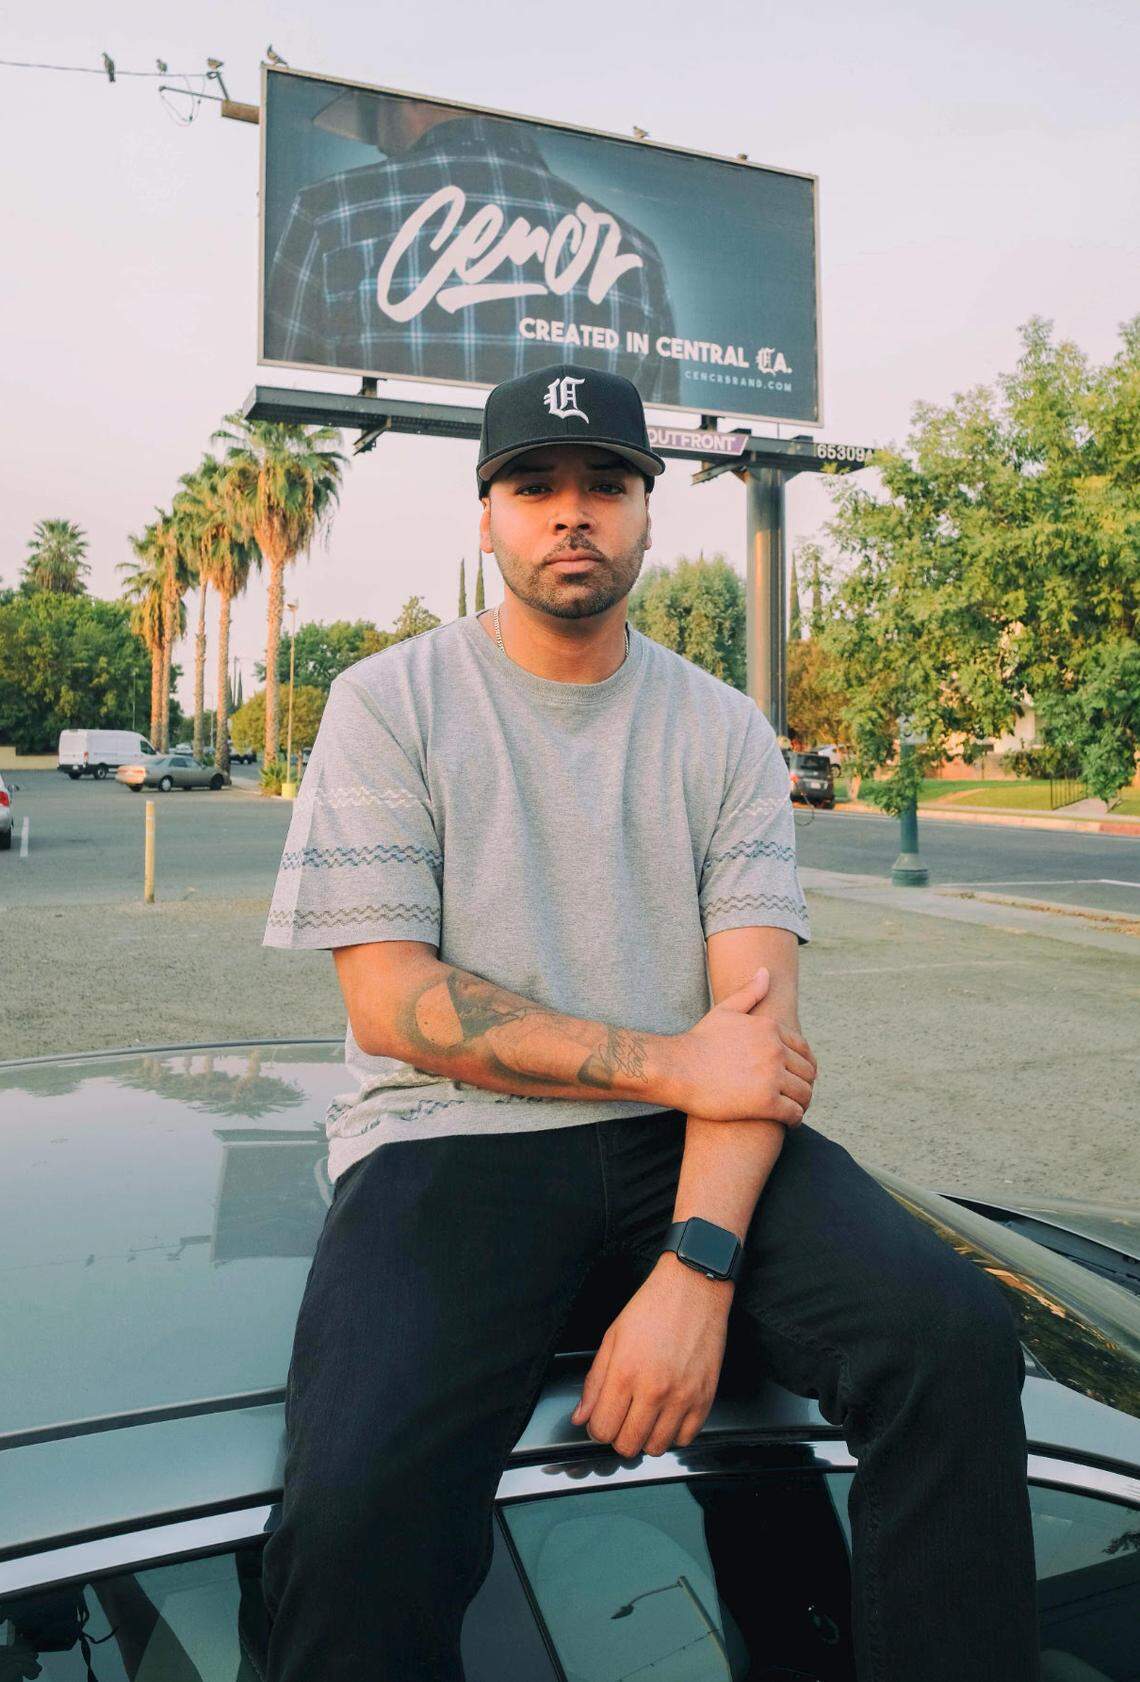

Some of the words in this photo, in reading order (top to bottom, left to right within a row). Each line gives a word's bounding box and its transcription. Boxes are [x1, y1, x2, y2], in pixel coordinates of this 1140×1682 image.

[518, 317, 620, 349] CREATED
[626, 331, 650, 355] IN
[655, 336, 750, 368] CENTRAL
[647, 428, 736, 451] OUTFRONT
